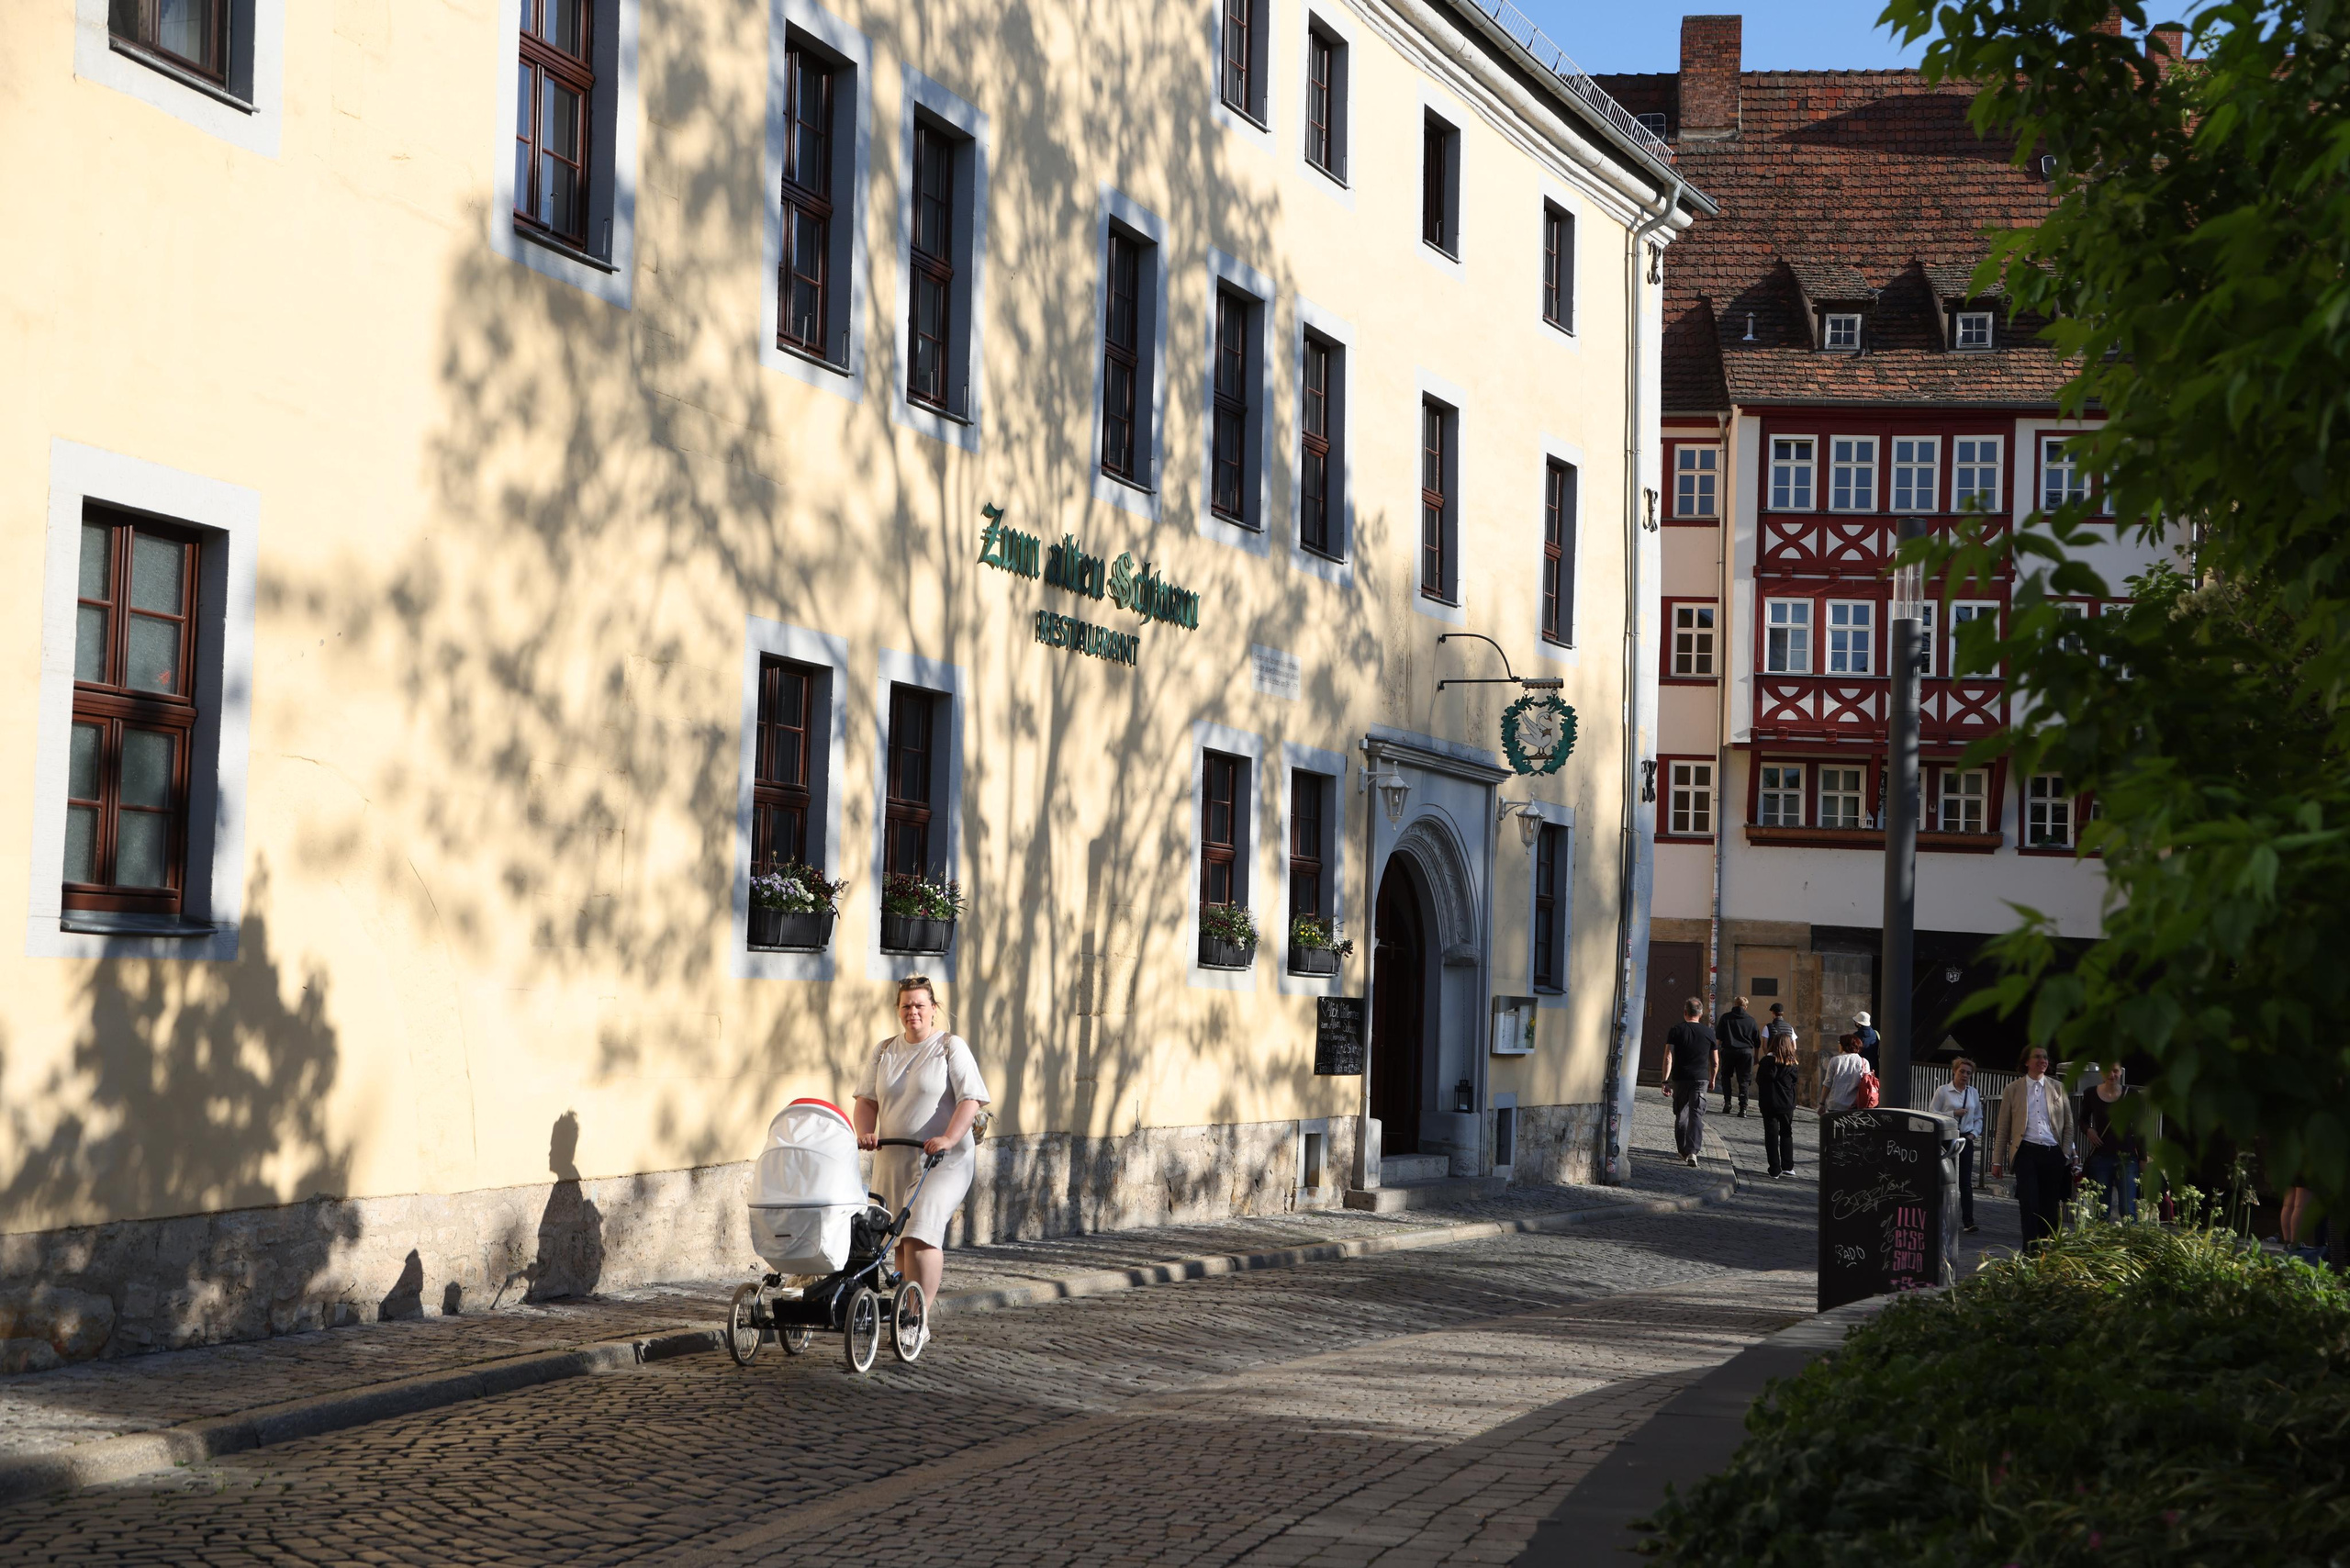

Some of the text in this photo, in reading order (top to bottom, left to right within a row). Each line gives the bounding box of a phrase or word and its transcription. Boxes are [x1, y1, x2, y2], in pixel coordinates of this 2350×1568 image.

[977, 502, 1201, 632] Zum alten Schwan
[1035, 610, 1140, 667] RESTAURANT
[1886, 1139, 1918, 1163] BADO
